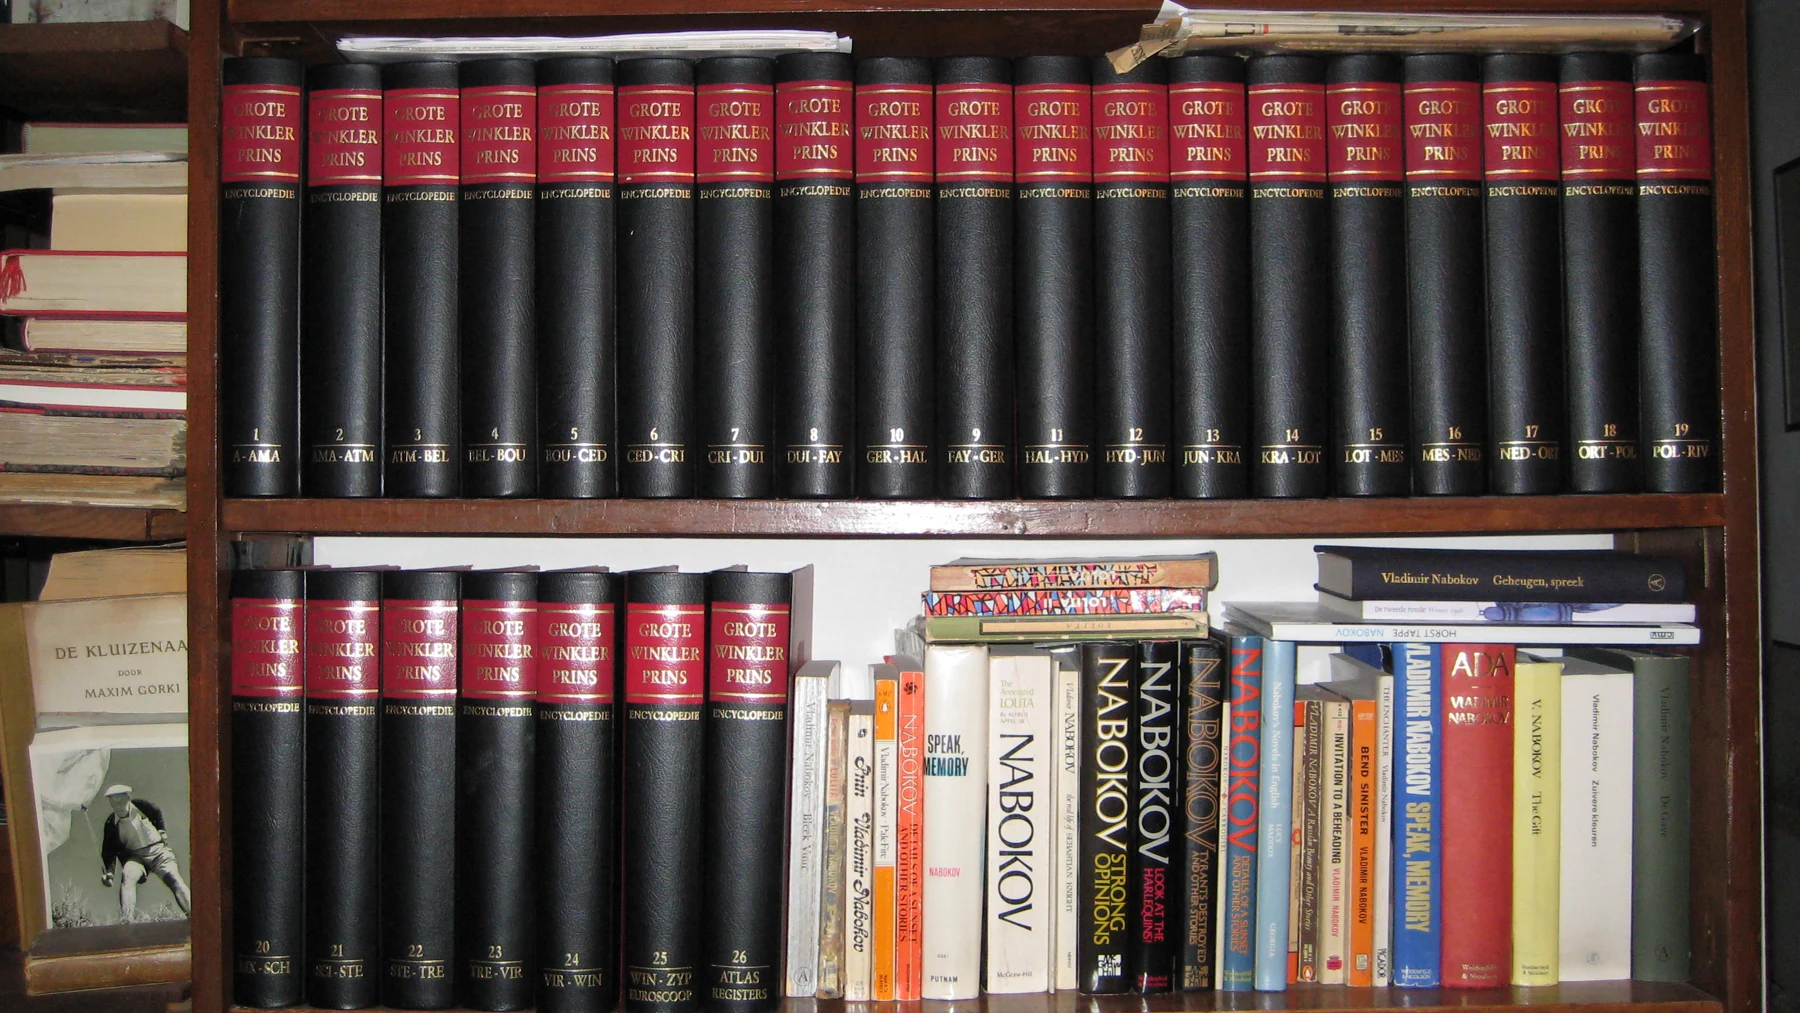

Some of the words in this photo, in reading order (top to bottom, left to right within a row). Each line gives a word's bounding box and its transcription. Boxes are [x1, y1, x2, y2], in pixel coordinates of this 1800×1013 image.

[708, 103, 761, 117] GROTE
[868, 102, 920, 116] GROTE
[1182, 101, 1233, 116] GROTE
[699, 126, 770, 141] WINKLER
[860, 125, 929, 140] WINKLER
[1173, 124, 1242, 139] WINKLER
[713, 148, 758, 163] PRINS
[873, 147, 918, 162] PRINS
[1187, 147, 1231, 161] PRINS
[700, 188, 771, 199] ENCYCLOPEDIE
[860, 187, 931, 199] ENCYCLOPEDIE
[1174, 186, 1243, 198] ENCYCLOPEDIE
[253, 428, 260, 441] 1
[731, 428, 739, 441] 7
[890, 428, 904, 442] 10
[1206, 429, 1220, 442] 13
[1674, 423, 1689, 437] 19
[1381, 572, 1429, 584] Vladimir
[1431, 573, 1479, 585] Nabokov
[1493, 575, 1549, 588] Geheugen,
[1550, 577, 1584, 589] spreek
[1061, 597, 1107, 608] LOLITA
[638, 623, 692, 638] GROTE
[724, 622, 776, 638] GROTE
[1335, 628, 1384, 637] NABOKOV
[1392, 629, 1421, 637] TAPPE
[1425, 629, 1457, 637] HORST
[55, 646, 78, 660] DE
[631, 646, 700, 661] WINKLER
[714, 645, 784, 660] WINKLER
[118, 669, 143, 677] DOOR
[1451, 652, 1510, 677] ADA
[642, 670, 687, 685] PRINS
[726, 669, 772, 684] PRINS
[1406, 643, 1431, 717] VLADIMIR
[84, 686, 133, 699] MAXIM
[138, 683, 180, 695] GORKI
[1066, 682, 1074, 709] Vladimir
[1382, 686, 1390, 703] THE
[629, 710, 699, 721] ENCYCLOPEDIE
[712, 708, 783, 720] ENCYCLOPEDIE
[1272, 682, 1281, 729] Nabokov's
[1531, 699, 1541, 709] V.
[1592, 694, 1600, 730] Vladimir
[804, 702, 816, 752] Vladimir
[1309, 703, 1320, 755] VLADIMIR
[1448, 712, 1510, 725] NABOKOV
[1381, 704, 1390, 757] ENCHANTER
[927, 735, 965, 756] SPEAK,
[1065, 712, 1075, 773] NABOKOV
[1096, 656, 1129, 852] NABOKOV
[1185, 656, 1220, 852] NABOKOV
[1228, 648, 1262, 853] NABOKOV
[1271, 730, 1281, 761] Novels
[1531, 715, 1541, 779] NABOKOV
[1591, 733, 1600, 772] Nabokov
[880, 747, 890, 782] Vladimir
[901, 714, 918, 815] NABOKOV
[924, 757, 969, 777] MEMORY
[1139, 660, 1171, 865] NABOKOV
[1271, 763, 1280, 772] in
[1334, 733, 1344, 787] INVITATION
[1361, 746, 1369, 777] BEND
[1406, 720, 1431, 796] NABOKOV
[803, 753, 814, 799] Nabokov
[853, 756, 871, 798] Pnin
[1308, 757, 1318, 806] NABOKOV
[1381, 764, 1389, 793] Vladimir
[880, 783, 890, 818] Nabokov
[1269, 775, 1280, 809] English
[1333, 788, 1343, 800] TO
[1531, 791, 1541, 814] The
[1591, 780, 1600, 813] Zuivere
[1307, 810, 1316, 818] A
[1360, 783, 1369, 835] SINISTER
[1380, 794, 1388, 824] Nabokov
[802, 813, 813, 841] Bleek
[880, 825, 890, 843] Pale
[998, 733, 1034, 931] NABOKOV
[1306, 818, 1316, 846] Russian
[1402, 802, 1431, 858] SPEAK,
[1531, 815, 1542, 835] Gift
[1591, 814, 1599, 847] kleuren
[853, 811, 871, 878] Vladimir
[899, 826, 908, 850] AND
[909, 824, 918, 870] DETAILS
[1267, 823, 1275, 857] MADDOX
[1332, 811, 1343, 864] BEHEADING
[802, 845, 811, 870] Vuur
[880, 844, 890, 859] Fire
[1191, 850, 1199, 873] AND
[1304, 848, 1315, 871] Beauty
[899, 852, 908, 891] OTHER
[929, 867, 961, 878] NABOKOV
[1199, 850, 1209, 900] TYRANTS
[1232, 855, 1241, 878] AND
[1240, 855, 1250, 893] DETAILS
[1359, 846, 1368, 883] VLADIMIR
[909, 872, 918, 886] OF
[1154, 867, 1164, 900] LOOK
[1191, 874, 1199, 906] OTHER
[1305, 871, 1314, 886] and
[1332, 867, 1340, 902] VLADIMIR
[1093, 853, 1110, 945] OPINIONS
[1110, 853, 1127, 932] STRONG
[1231, 879, 1240, 912] OTHER
[1240, 895, 1249, 907] OF
[1305, 886, 1314, 906] Other
[1405, 860, 1431, 933] MEMORY
[852, 880, 870, 953] Nabokov
[1141, 867, 1154, 944] HARLEQUINS!
[1154, 902, 1164, 917] AT
[1240, 909, 1249, 917] A
[1358, 887, 1367, 924] NABOKOV
[899, 894, 908, 942] STORIES
[908, 899, 918, 944] SUNSET
[1189, 909, 1199, 945] STORIES
[1303, 908, 1313, 931] Stories
[1331, 904, 1340, 938] NABOKOV
[1154, 920, 1164, 941] THE
[1197, 902, 1207, 963] DESTROYED
[1230, 914, 1240, 952] STORIES
[1239, 919, 1248, 954] SUNSET
[1269, 923, 1277, 957] GEORGIA
[408, 944, 424, 957] 22
[652, 951, 668, 965] 25
[731, 950, 747, 964] 26
[1378, 948, 1387, 979] PICADOR
[720, 971, 759, 984] ATLAS
[931, 975, 958, 983] PUTNAM
[629, 990, 692, 1002] EUROSCOOP
[712, 988, 768, 1000] REGISTERS
